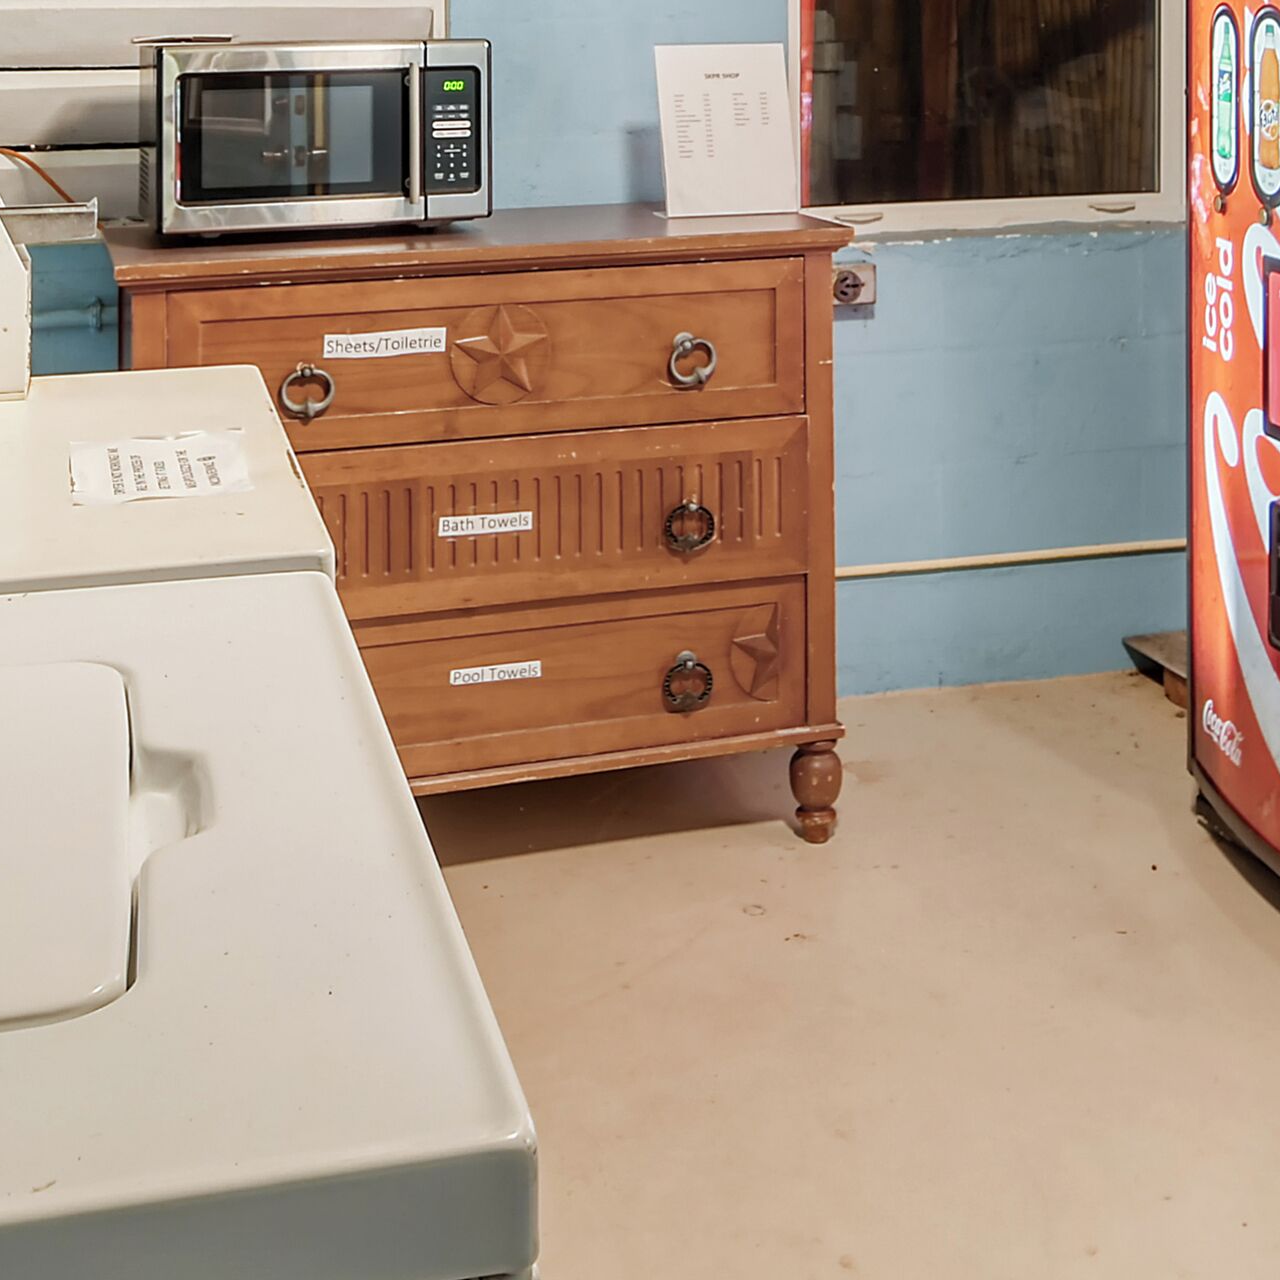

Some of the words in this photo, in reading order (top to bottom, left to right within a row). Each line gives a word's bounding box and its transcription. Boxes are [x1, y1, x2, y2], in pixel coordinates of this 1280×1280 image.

[1202, 272, 1217, 353] ice
[1216, 237, 1233, 362] cold
[326, 336, 442, 354] Sheets/Toiletrie
[442, 518, 474, 532] Bath
[480, 514, 529, 529] Towels
[453, 669, 484, 683] Pool
[489, 664, 538, 680] Towels
[1203, 699, 1244, 767] Coca-Cola
